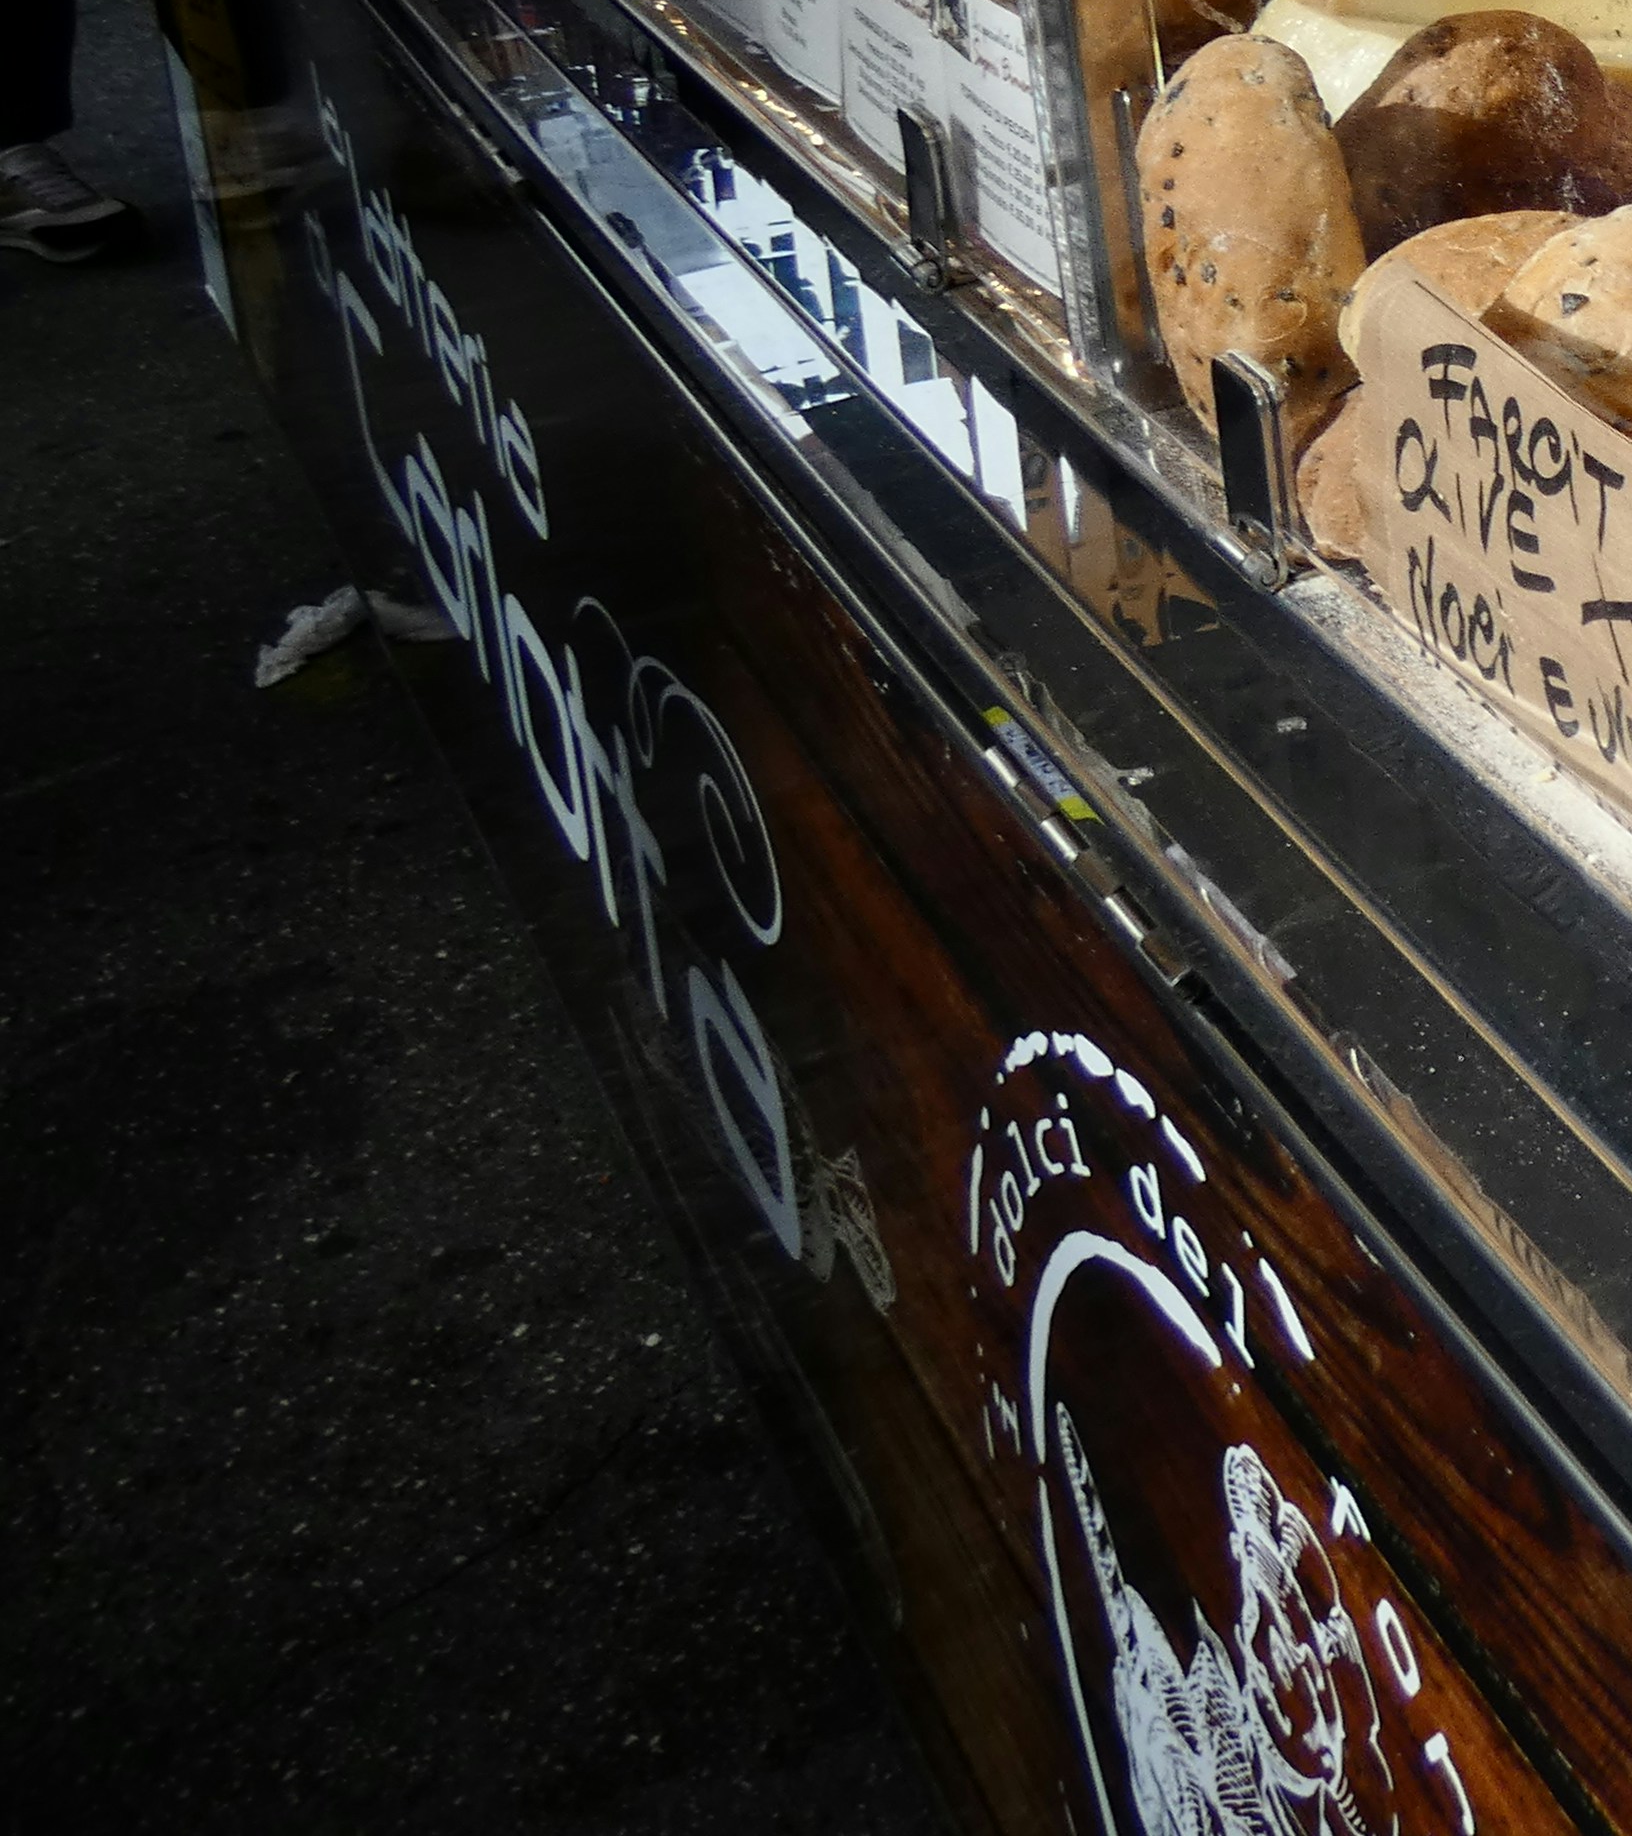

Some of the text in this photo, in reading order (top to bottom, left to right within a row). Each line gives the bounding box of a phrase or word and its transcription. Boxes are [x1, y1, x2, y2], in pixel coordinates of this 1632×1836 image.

[344, 130, 549, 541] latteria
[336, 269, 800, 1260] Carlotta
[1540, 655, 1581, 739] E
[990, 1092, 1092, 1288] dolci
[1129, 1162, 1256, 1369] del
